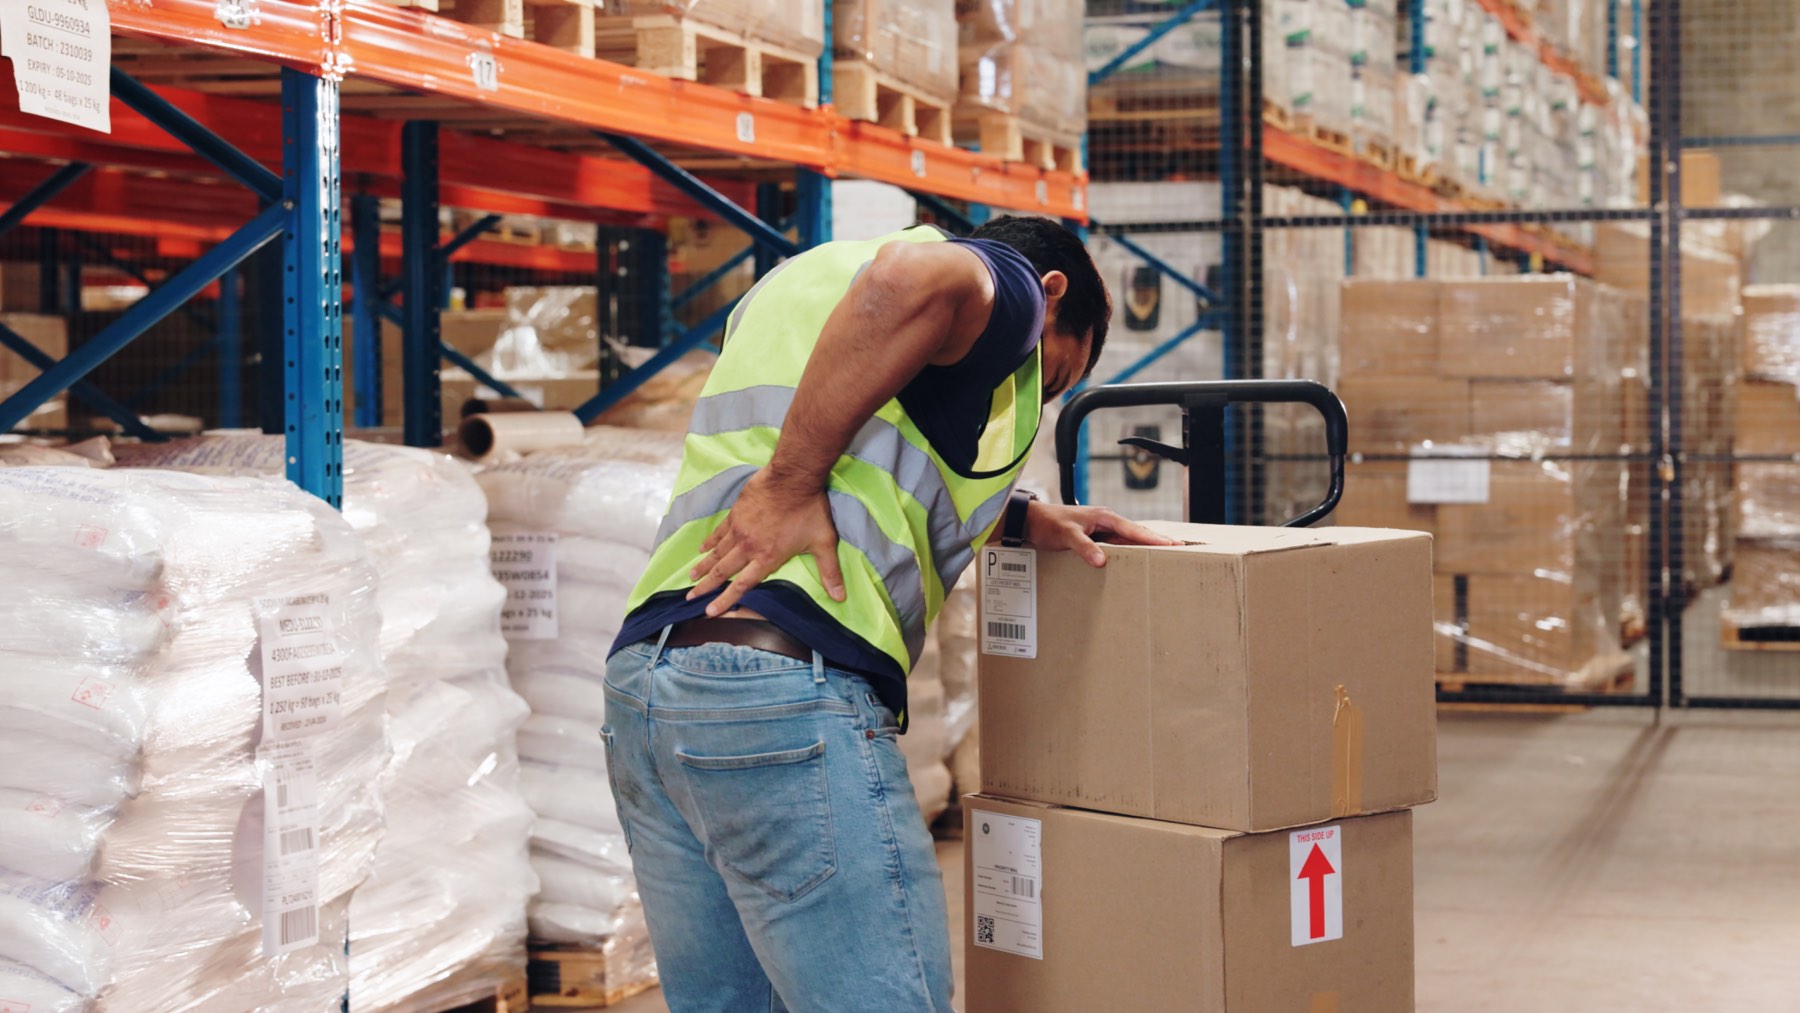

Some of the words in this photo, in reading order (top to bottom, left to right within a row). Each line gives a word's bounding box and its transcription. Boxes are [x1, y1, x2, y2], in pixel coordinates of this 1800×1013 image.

[28, 5, 90, 34] GLDU-9960934
[27, 32, 54, 52] BATCH
[60, 41, 93, 62] 2310039
[27, 59, 51, 74] EXPIRY
[479, 59, 492, 85] 17
[988, 551, 997, 577] P
[270, 675, 285, 689] BEST
[286, 672, 310, 687] BEFORE
[1297, 833, 1310, 843] THIS
[1311, 831, 1325, 841] SIDE
[1326, 830, 1334, 839] UP
